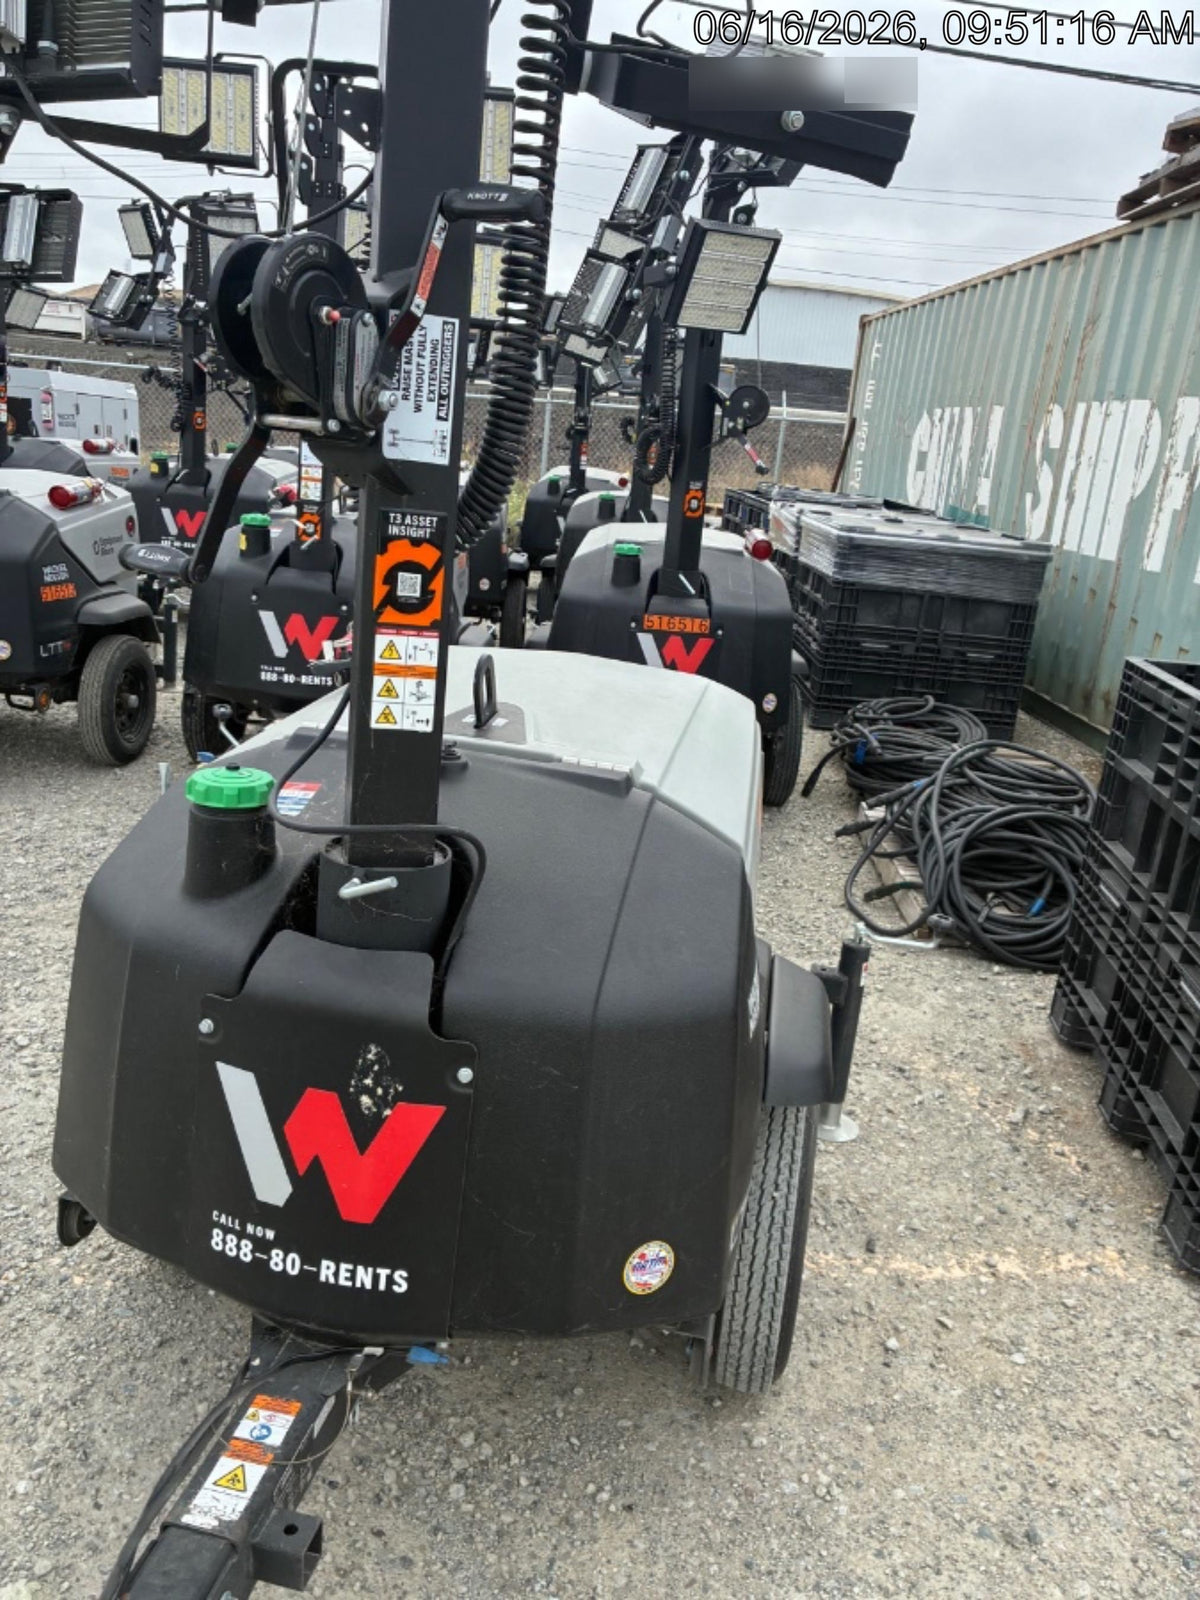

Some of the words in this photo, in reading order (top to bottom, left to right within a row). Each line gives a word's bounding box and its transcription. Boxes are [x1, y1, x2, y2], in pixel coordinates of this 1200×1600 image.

[416, 325, 428, 360] FULLY
[440, 323, 454, 396] OUTRIGGERS
[401, 367, 413, 401] RAISE
[413, 360, 426, 413] WITHOUT
[427, 338, 439, 402] EXTENDING
[438, 397, 449, 419] ALL
[388, 513, 402, 524] T3
[405, 514, 438, 527] ASSET
[645, 616, 709, 632] 516516
[260, 671, 333, 685] 888-80-RENTS
[212, 1210, 241, 1230] CALL
[246, 1223, 276, 1241] NOW
[211, 1228, 409, 1293] 888-80-RENTS
